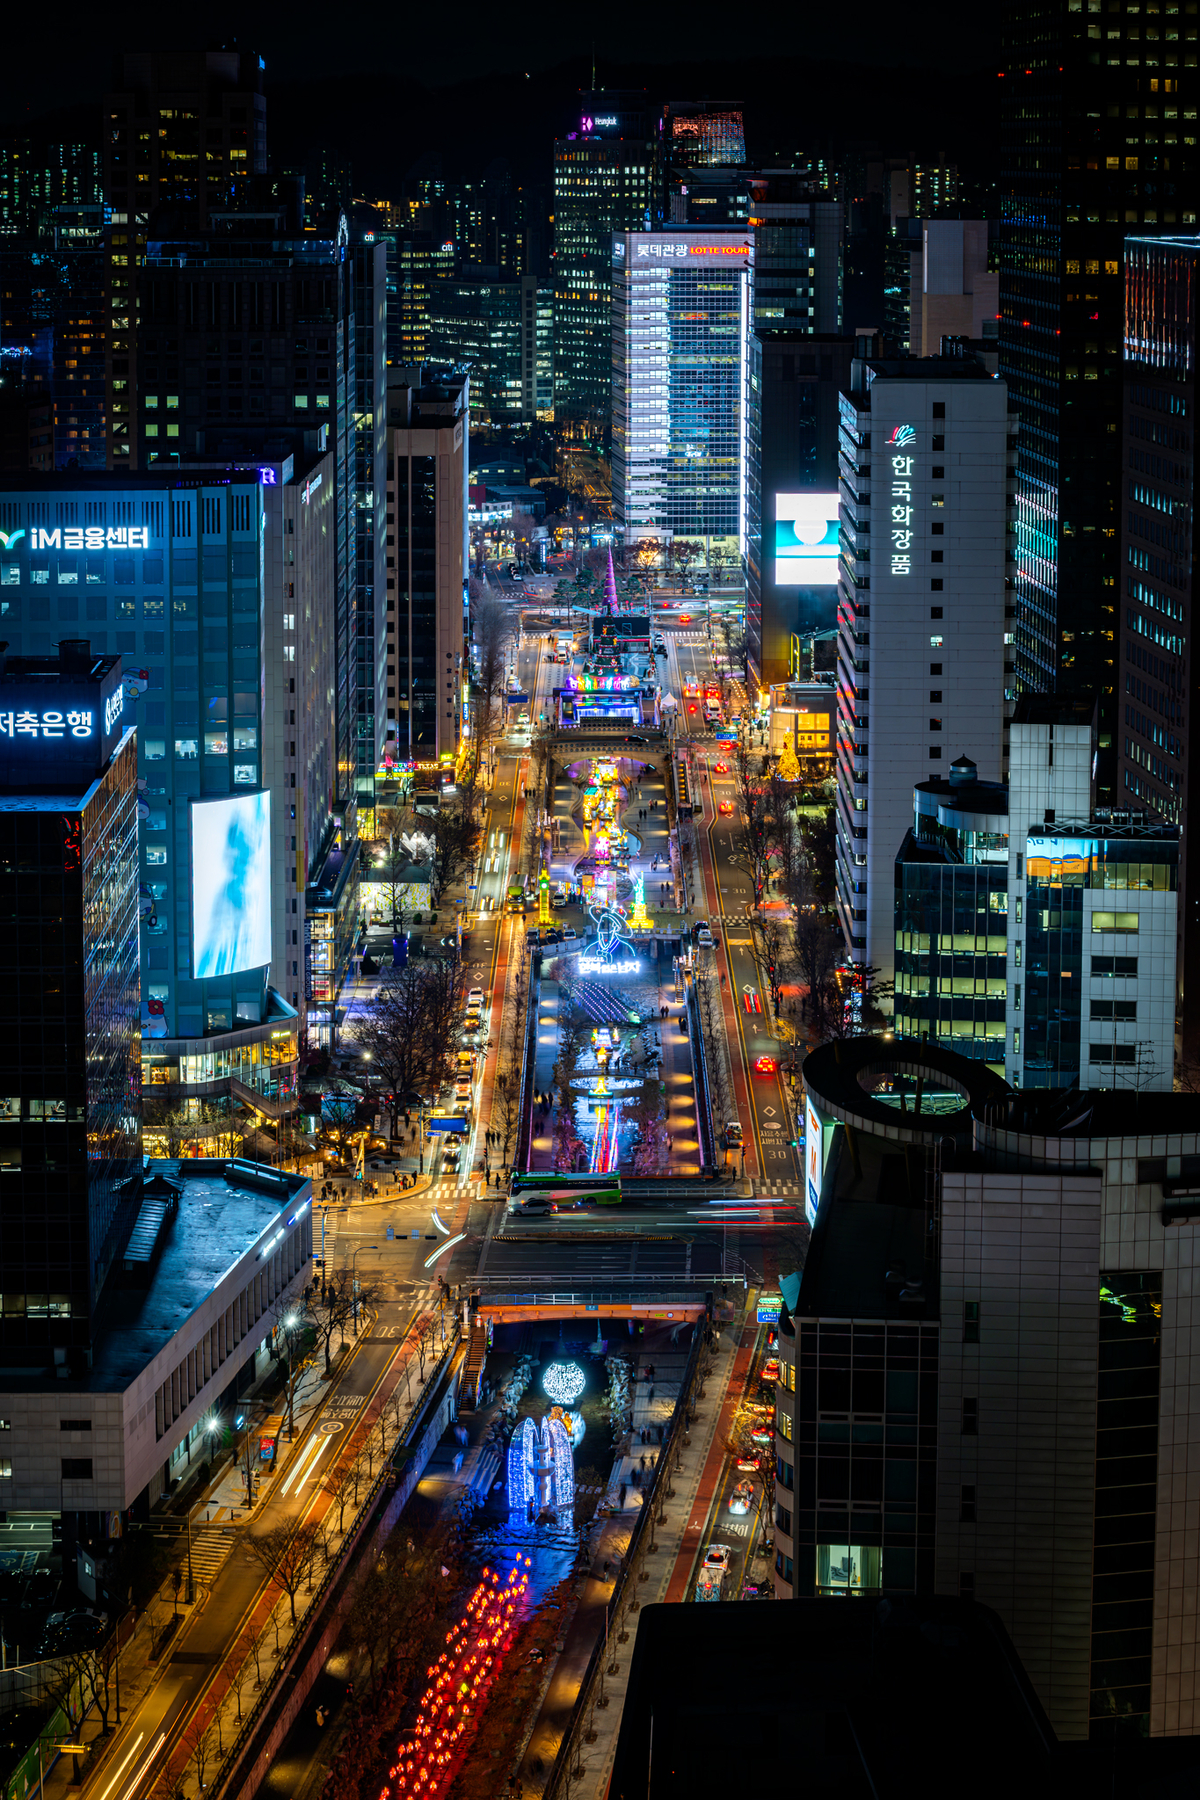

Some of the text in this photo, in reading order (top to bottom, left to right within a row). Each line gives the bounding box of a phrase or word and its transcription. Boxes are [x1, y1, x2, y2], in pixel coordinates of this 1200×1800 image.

[441, 241, 453, 251] citi
[637, 244, 688, 257] 롯데관광
[690, 246, 720, 255] LOTTE
[891, 455, 914, 575] 한국화장품
[0, 711, 92, 737] 저축은행
[768, 1150, 787, 1160] 30
[376, 1326, 400, 1338] 30
